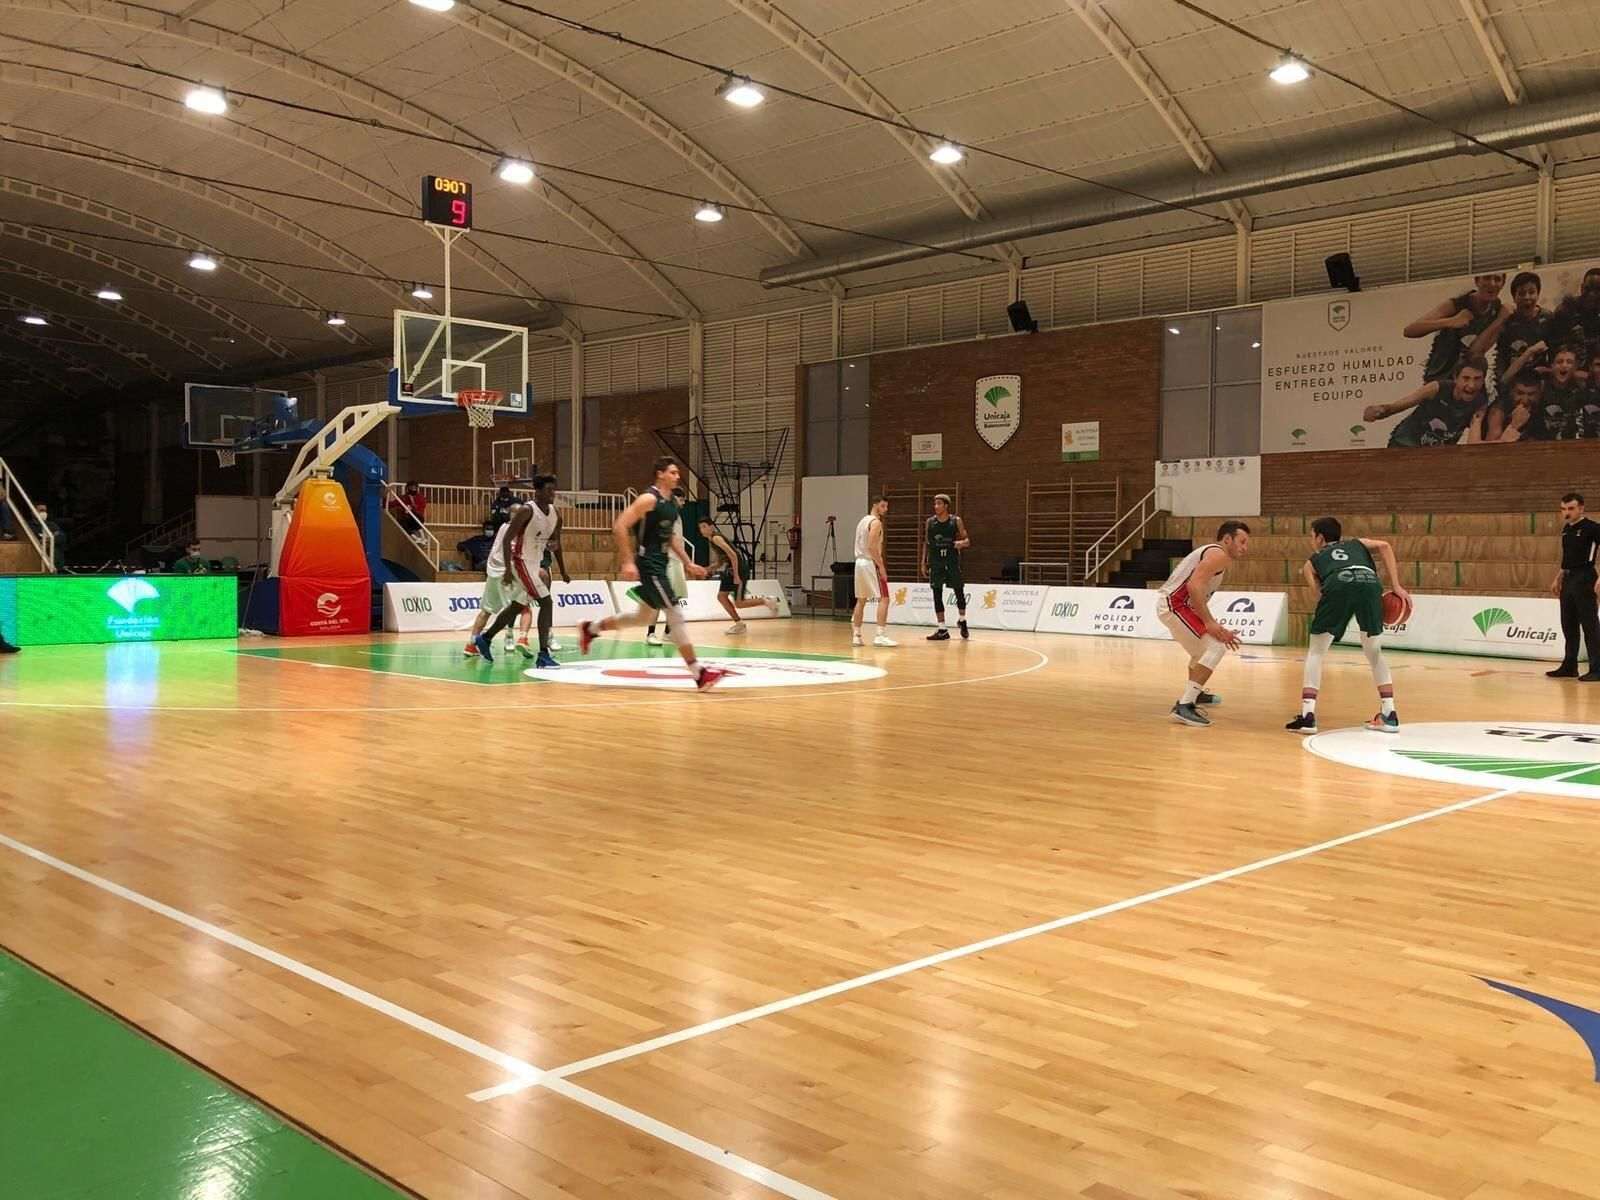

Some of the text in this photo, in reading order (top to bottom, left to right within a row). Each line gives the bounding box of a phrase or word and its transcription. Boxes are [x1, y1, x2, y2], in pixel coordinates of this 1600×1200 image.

[451, 199, 466, 224] 9
[1296, 345, 1384, 359] NUESTROS VALORES
[1267, 355, 1415, 377] ESFUERZO HUMILDAD
[1275, 370, 1406, 391] ENTREGA TRABAJO
[1313, 389, 1364, 401] EQUIPO
[983, 411, 1011, 421] Unicaja
[1331, 548, 1349, 561] 6
[1094, 614, 1141, 622] HOLIDAY
[1215, 618, 1263, 626] OLIDAY
[1094, 624, 1134, 632] WORLD
[1506, 626, 1558, 643] Unicaja
